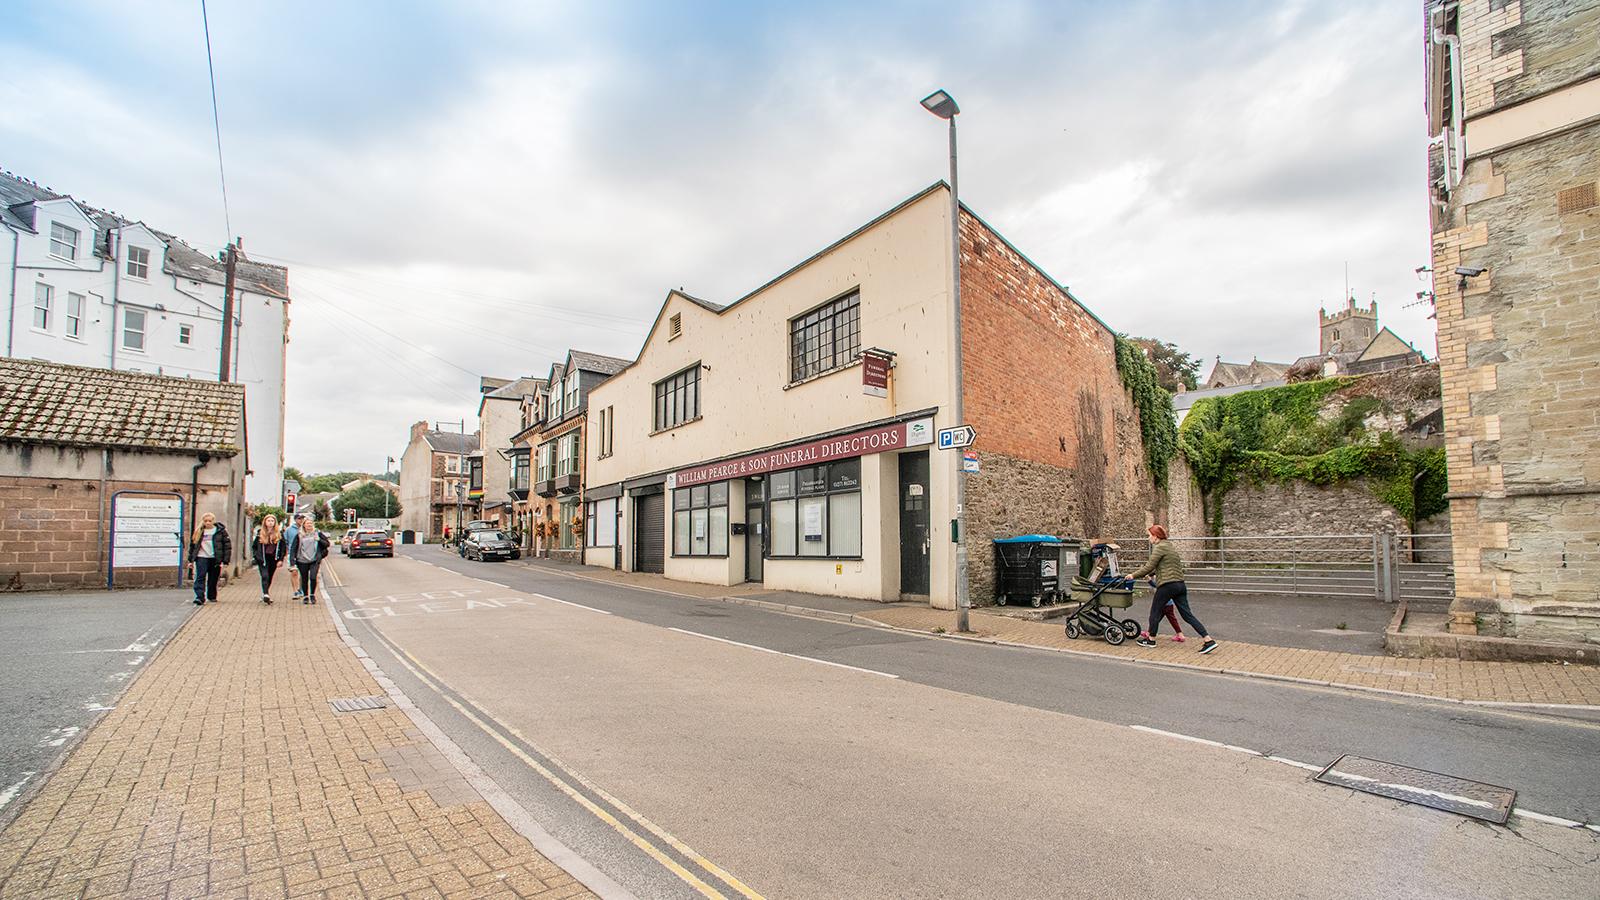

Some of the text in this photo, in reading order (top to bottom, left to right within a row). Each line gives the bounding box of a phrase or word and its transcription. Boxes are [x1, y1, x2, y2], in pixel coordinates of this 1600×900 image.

[943, 433, 951, 445] P
[678, 470, 708, 483] WILLIAM
[708, 463, 739, 479] PEARCE
[740, 461, 746, 473] &
[748, 456, 768, 471] SON
[770, 449, 818, 470] FUNERAL
[821, 430, 899, 457] DIRECTORS
[351, 589, 482, 605] KEEP
[343, 599, 536, 619] CLEAR
